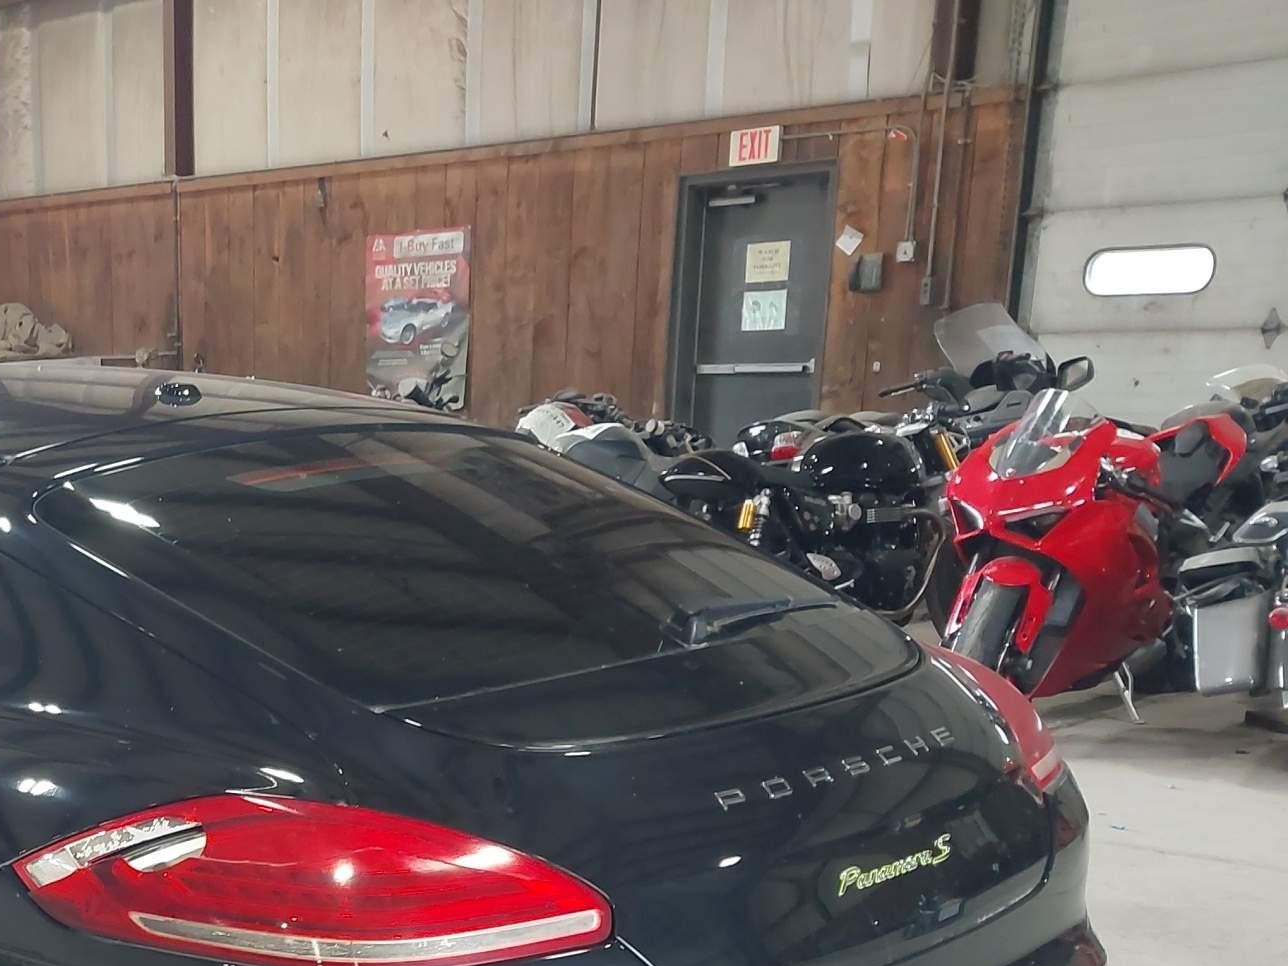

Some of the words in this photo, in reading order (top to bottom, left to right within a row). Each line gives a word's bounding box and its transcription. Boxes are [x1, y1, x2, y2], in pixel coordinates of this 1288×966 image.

[738, 130, 771, 161] EXIT
[432, 236, 455, 250] Fast
[375, 263, 414, 279] QUALITY
[413, 260, 456, 276] VEHICLES
[381, 278, 394, 292] AT
[394, 277, 403, 290] A
[714, 725, 955, 811] PORSCHE
[838, 849, 933, 897] Panamera
[932, 833, 952, 865] S
